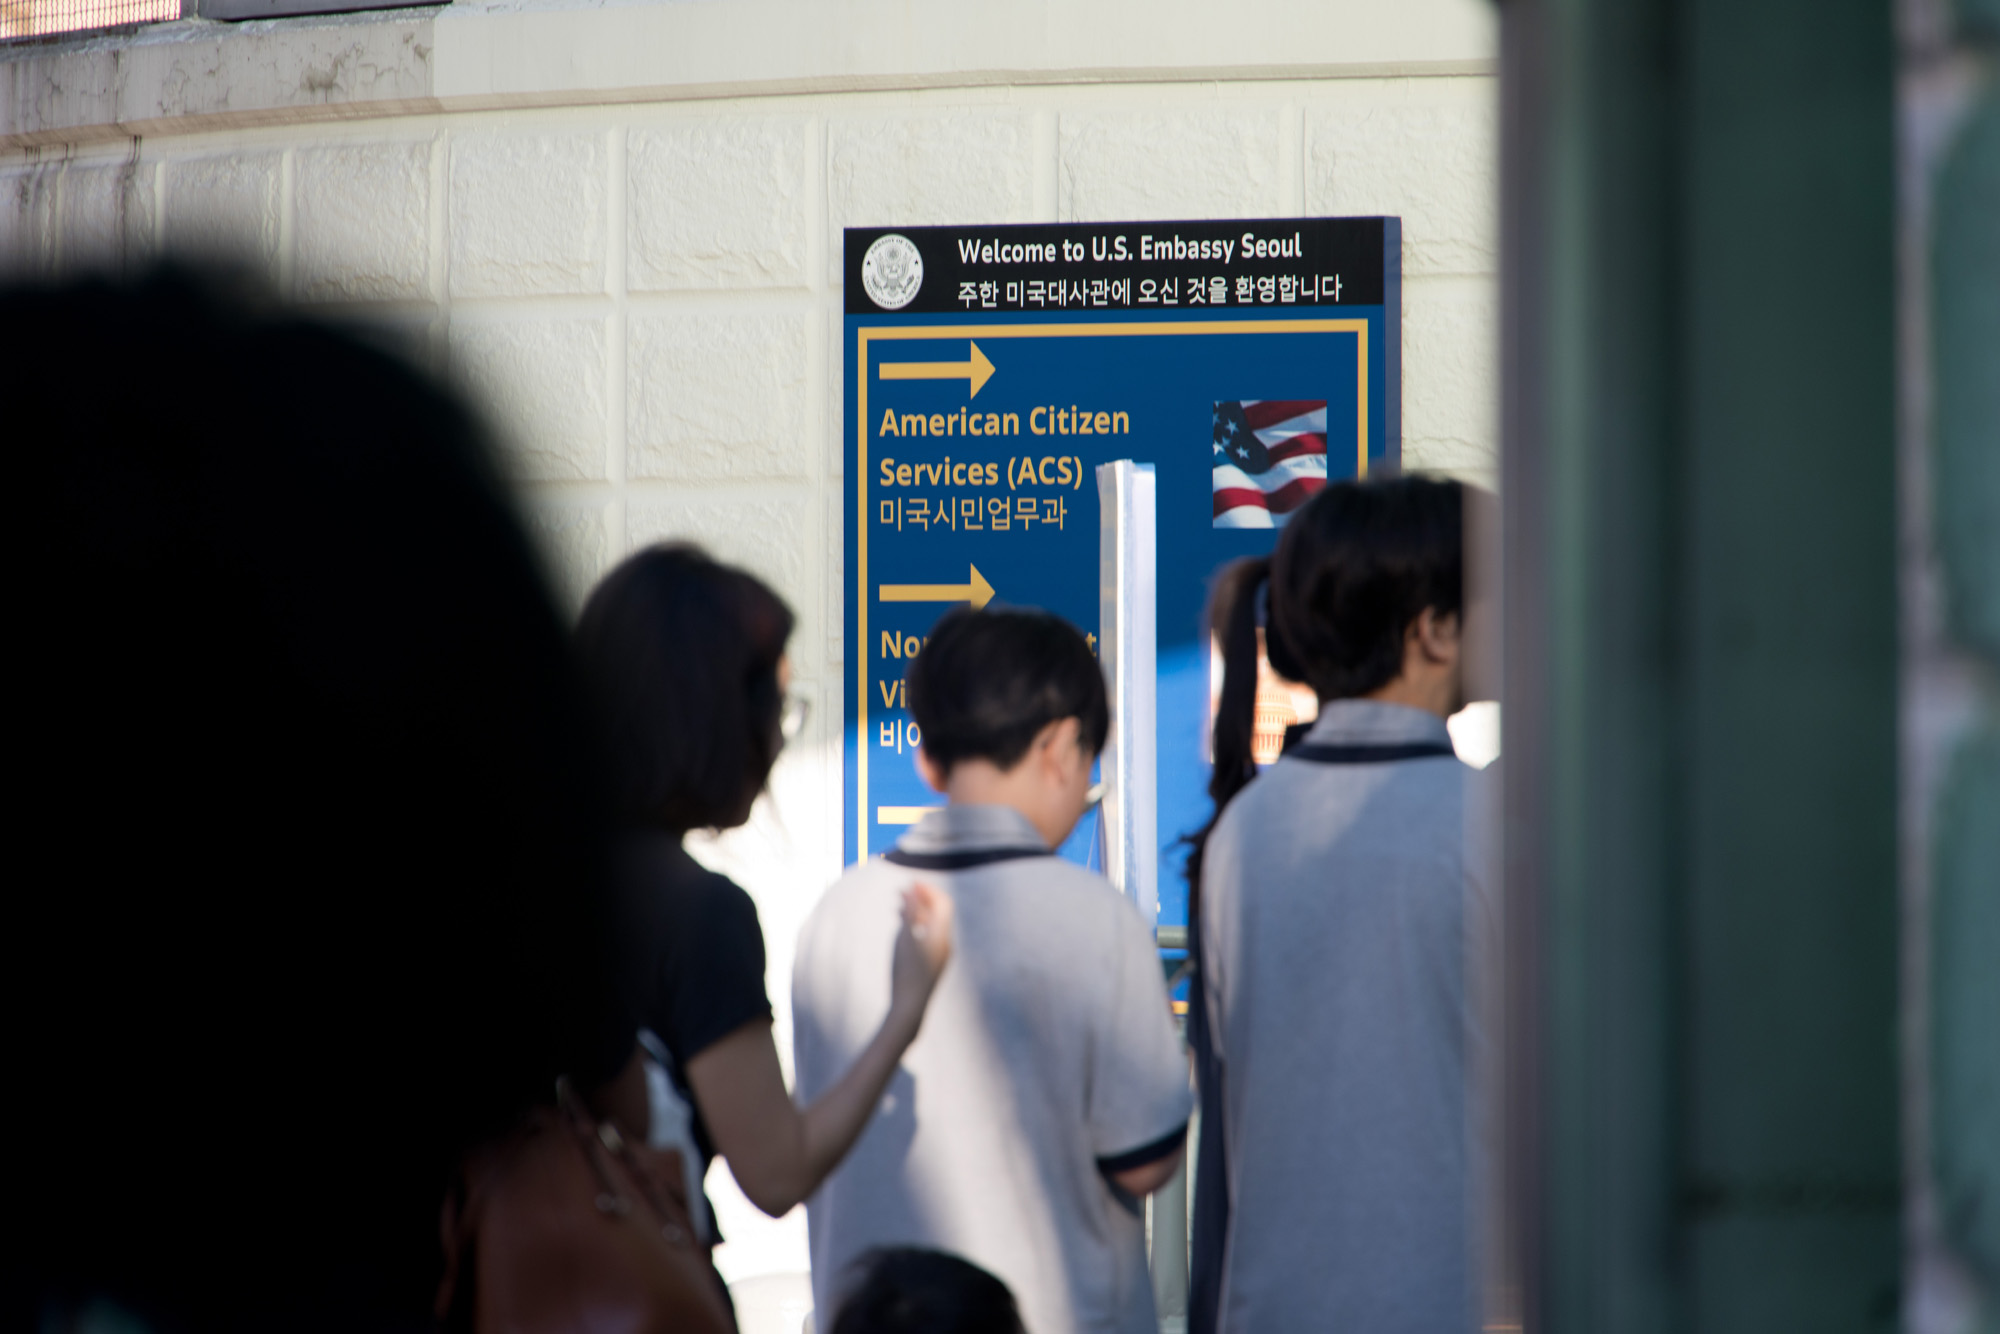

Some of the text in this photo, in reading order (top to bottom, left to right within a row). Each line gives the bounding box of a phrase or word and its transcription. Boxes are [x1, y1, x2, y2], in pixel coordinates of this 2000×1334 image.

[957, 231, 1302, 265] Welcome to U.S. Embassy Seoul
[957, 273, 1343, 309] 주한 미국대사관에 오신 것을 환영합니다
[879, 404, 1129, 437] American Citizen
[880, 456, 1083, 490] Services (ACS)
[880, 495, 1068, 532] 미국시민업무과
